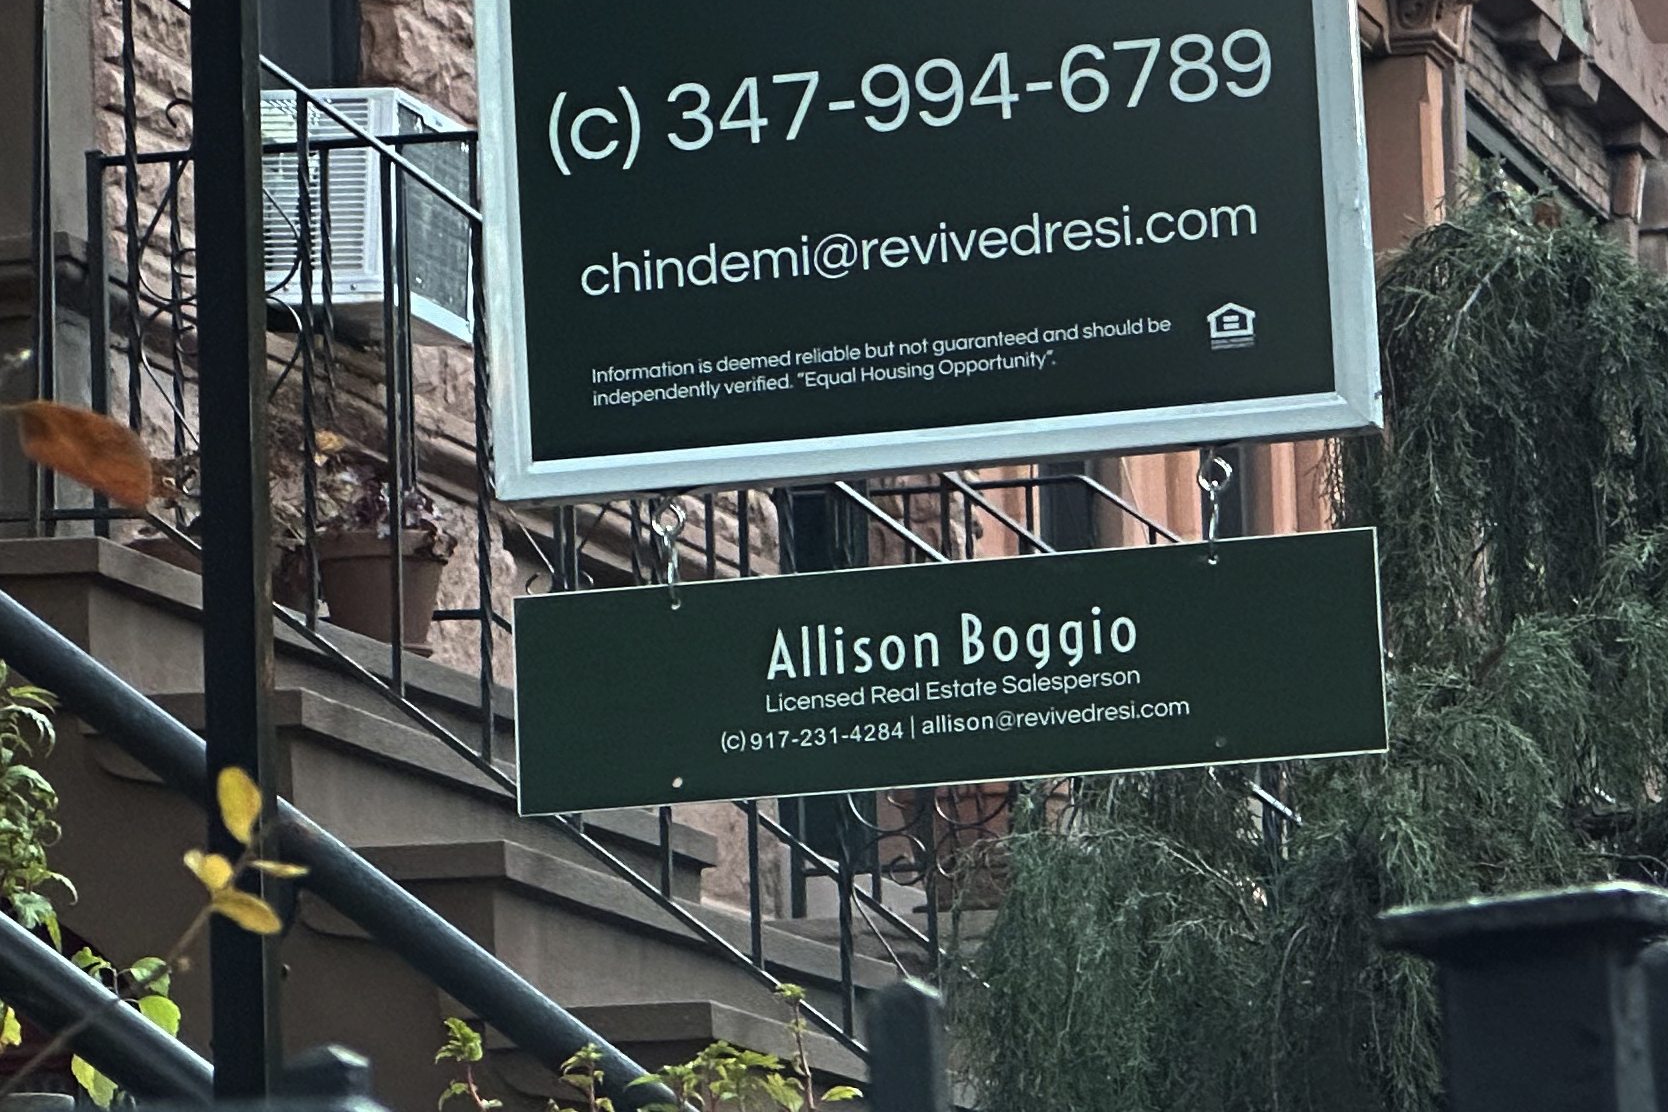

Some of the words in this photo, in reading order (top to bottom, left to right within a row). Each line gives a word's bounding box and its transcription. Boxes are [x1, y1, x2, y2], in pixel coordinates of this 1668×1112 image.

[549, 86, 640, 175] (c)
[667, 29, 1271, 150] 347-994-6789
[581, 204, 1257, 295] chindemi@revivedresi.com
[592, 361, 694, 383] Information
[698, 359, 712, 373] is
[716, 351, 791, 372] deemed
[796, 345, 861, 365] reliable
[865, 341, 894, 358] but
[899, 338, 928, 355] not
[932, 328, 1039, 355] guaranteed
[1043, 324, 1078, 342] and
[1083, 318, 1143, 339] should
[1148, 318, 1171, 333] be
[593, 381, 720, 406] independently
[724, 373, 793, 394] verified.
[861, 363, 934, 382] Housing
[767, 625, 939, 680] Allison
[961, 606, 1136, 669] Boggio
[766, 687, 864, 712] Licensed
[871, 682, 920, 704] Real
[926, 678, 997, 700] Estate
[1003, 670, 1140, 694] Salesperson
[922, 701, 1189, 734] allison@revivedresi.com
